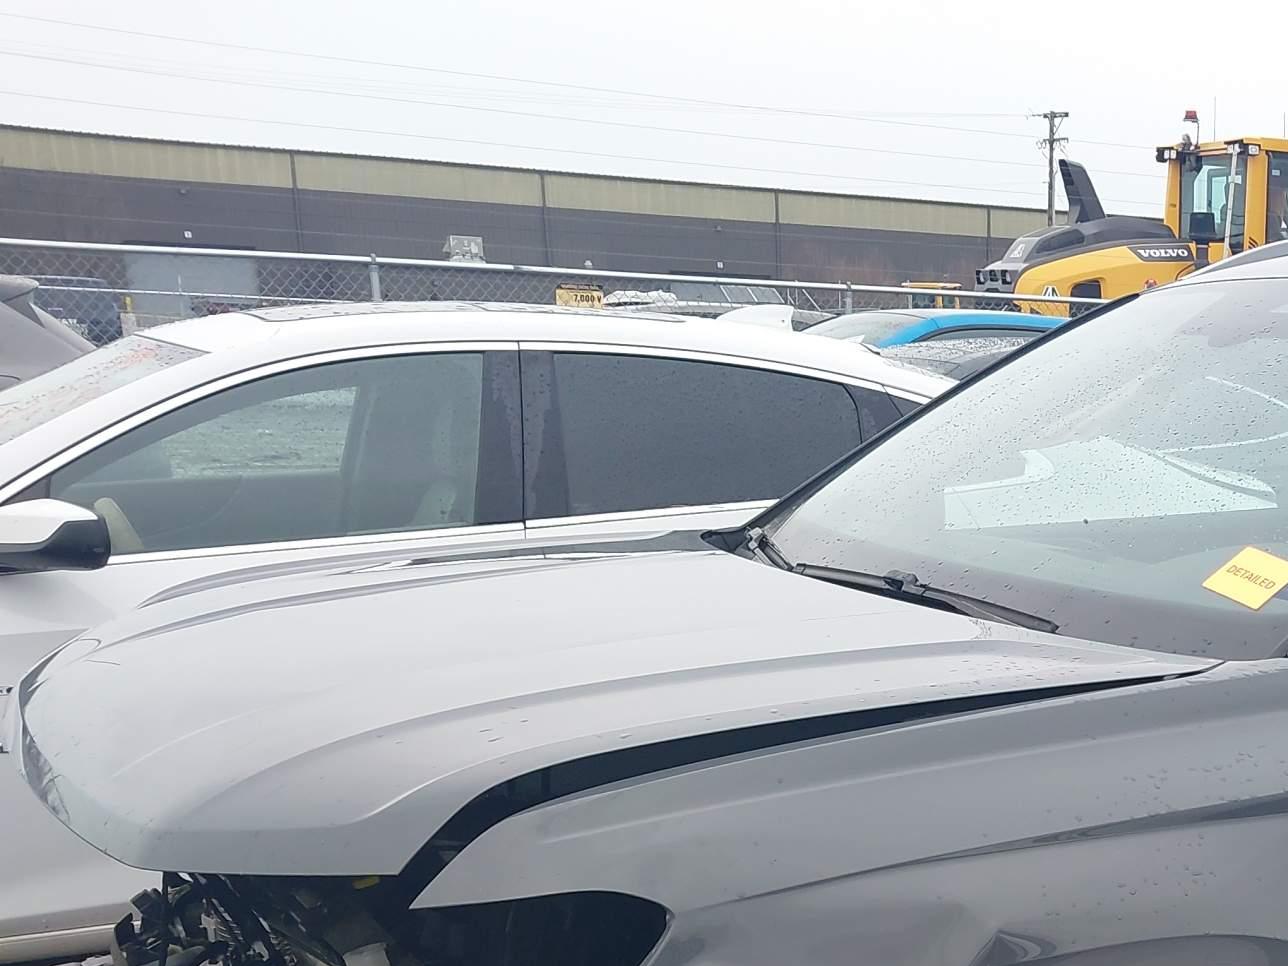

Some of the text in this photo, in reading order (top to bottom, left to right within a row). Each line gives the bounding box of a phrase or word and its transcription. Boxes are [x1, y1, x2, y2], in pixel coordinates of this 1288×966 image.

[1137, 249, 1188, 257] VOLVO
[573, 293, 595, 304] 7,000
[1226, 564, 1276, 590] DETAILED
